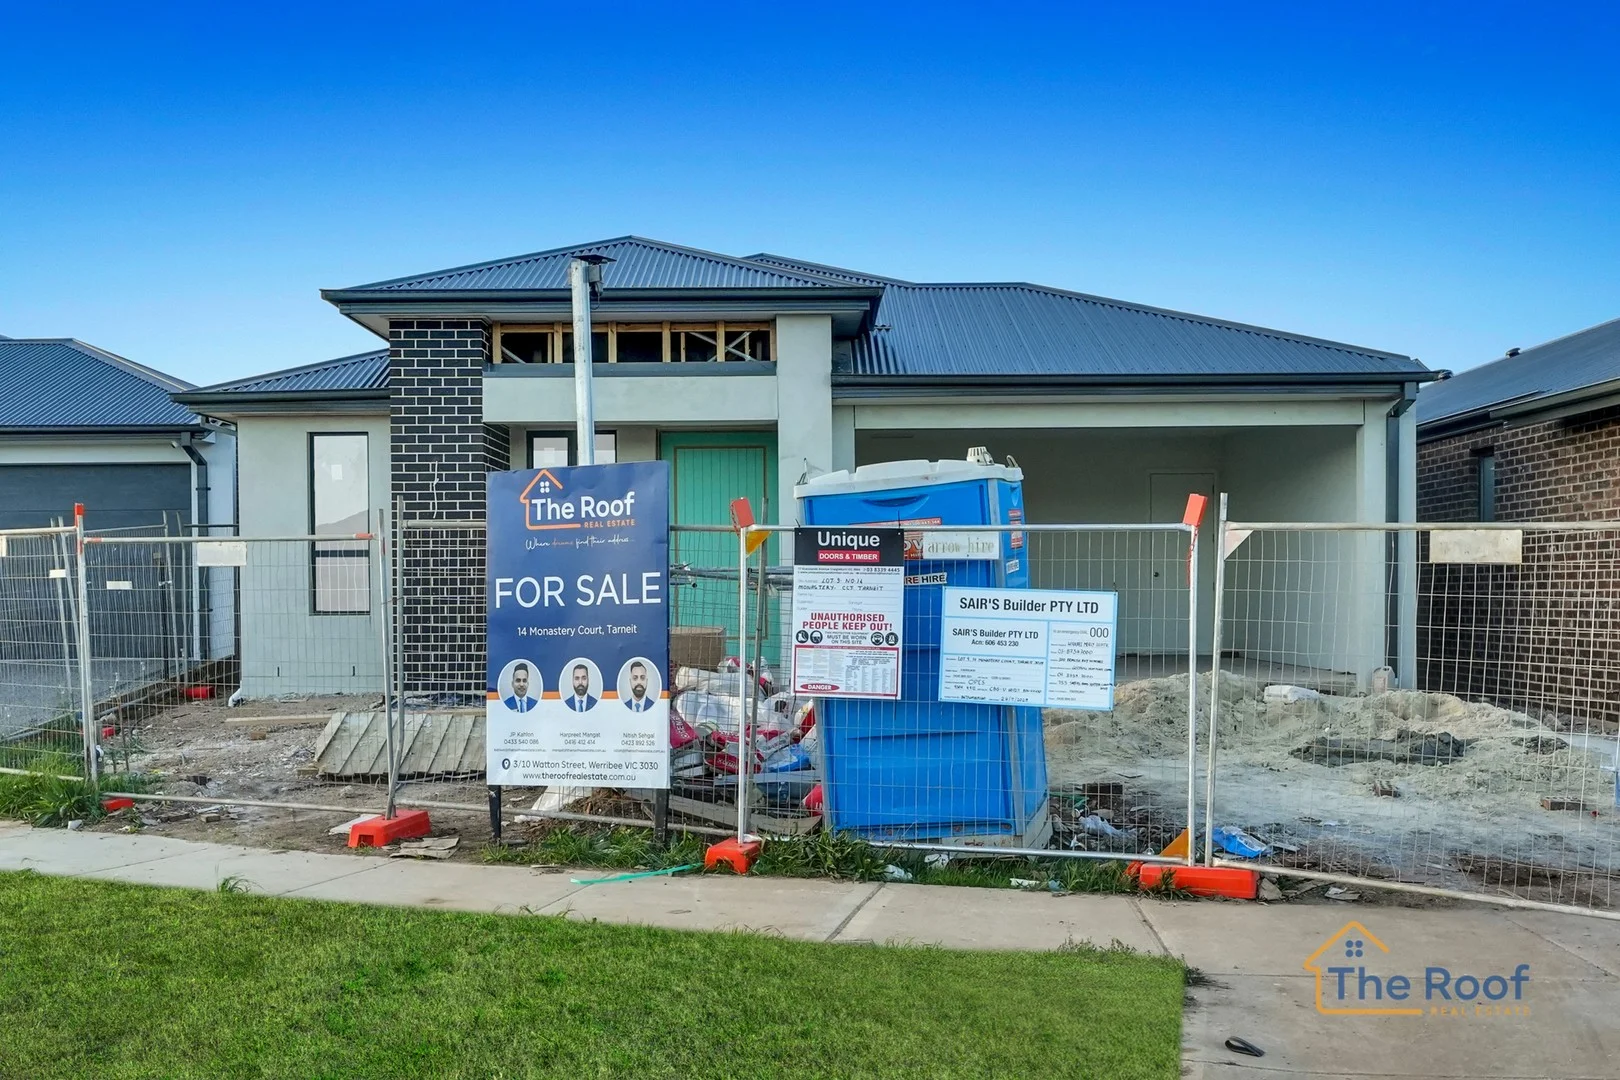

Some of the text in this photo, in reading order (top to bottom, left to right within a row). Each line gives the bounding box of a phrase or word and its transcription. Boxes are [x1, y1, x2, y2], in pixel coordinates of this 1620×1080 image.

[531, 491, 635, 521] The Roof
[584, 519, 635, 529] REAL ESTATE
[817, 531, 880, 549] Unique
[967, 537, 994, 554] hire
[921, 574, 946, 583] HIRE
[495, 571, 662, 608] FOR SALE
[959, 597, 1099, 614] SAIR'S Builder PTY LTD
[810, 612, 885, 622] UNAUTHORISED
[517, 623, 638, 637] 14 Monastery Court, Tarneit
[803, 621, 893, 631] PEOPLE KEEP OUT!
[952, 628, 978, 636] SAIR'S
[979, 630, 1006, 638] Builder
[1008, 631, 1023, 639] PTY
[1089, 627, 1109, 638] 000
[532, 761, 560, 769] Watton
[561, 761, 587, 769] Street,
[588, 761, 623, 770] Werribee
[639, 762, 659, 770] 3030
[522, 772, 637, 781] www.theroofrealestate.com.au
